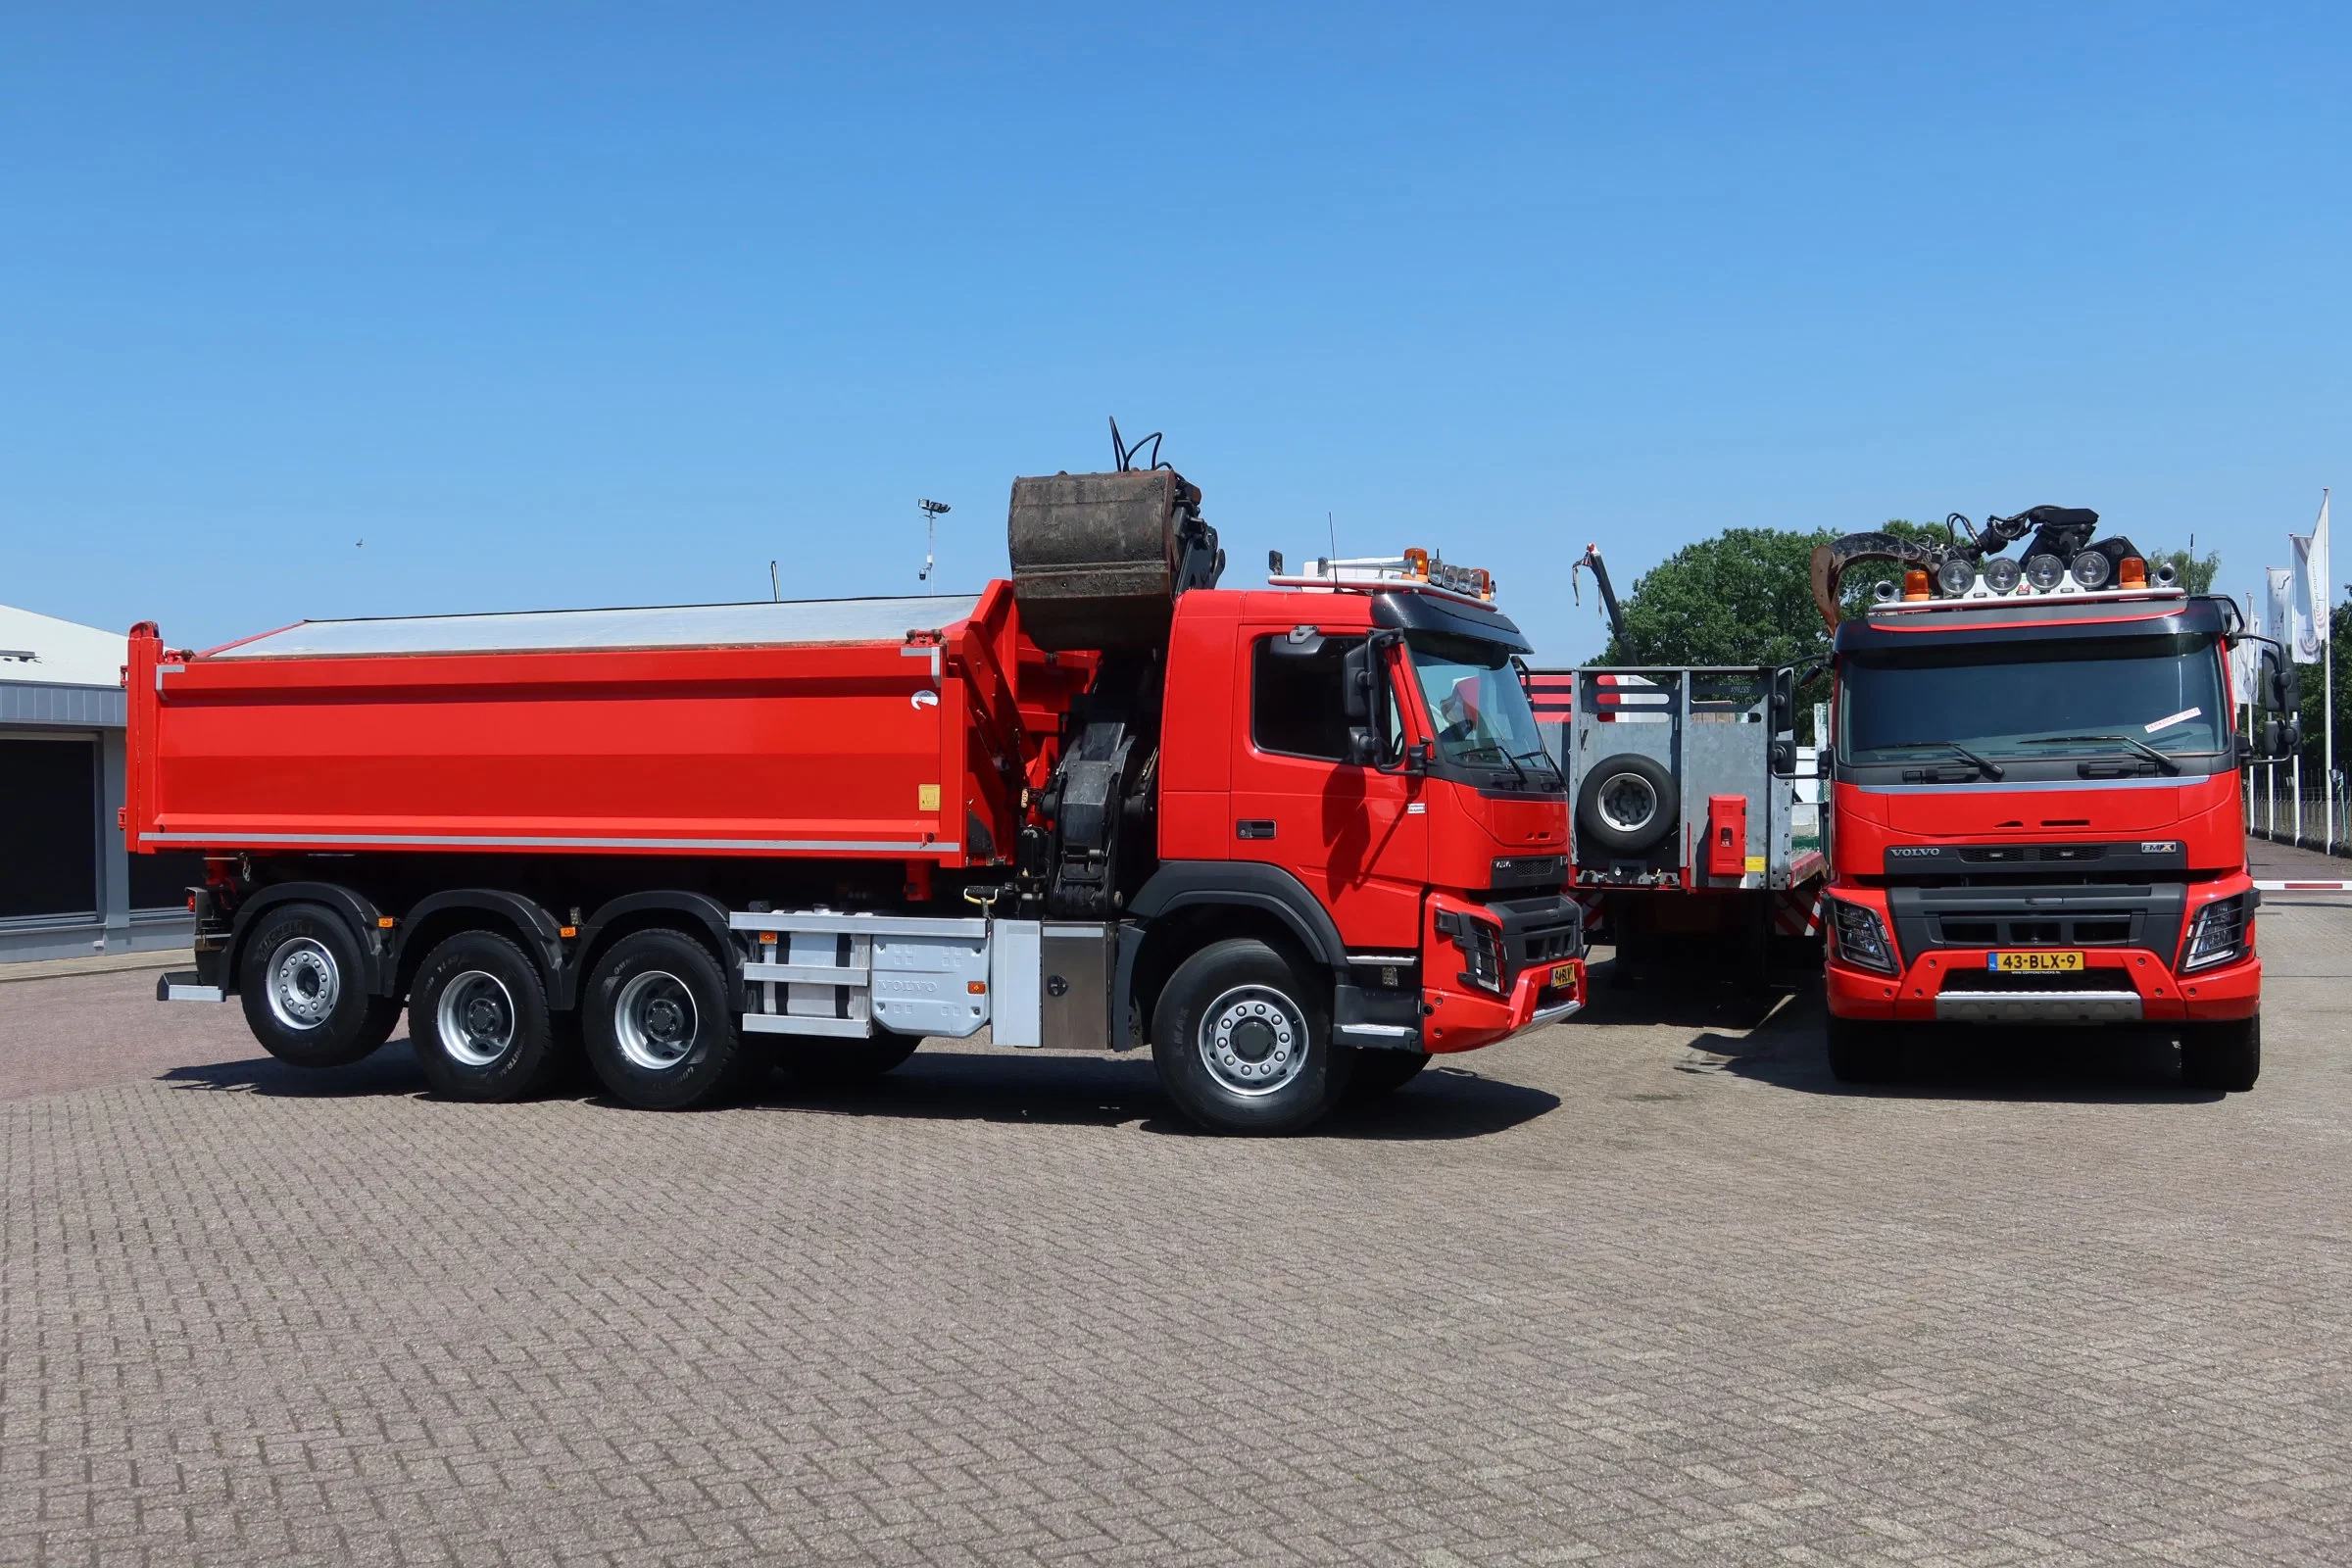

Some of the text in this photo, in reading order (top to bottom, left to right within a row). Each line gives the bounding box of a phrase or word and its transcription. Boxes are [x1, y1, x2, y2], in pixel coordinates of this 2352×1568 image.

[1890, 848, 1940, 857] VOLVO
[2142, 843, 2175, 853] FMX
[2002, 954, 2077, 969] 43-BLX-9
[877, 979, 939, 993] VOLVO
